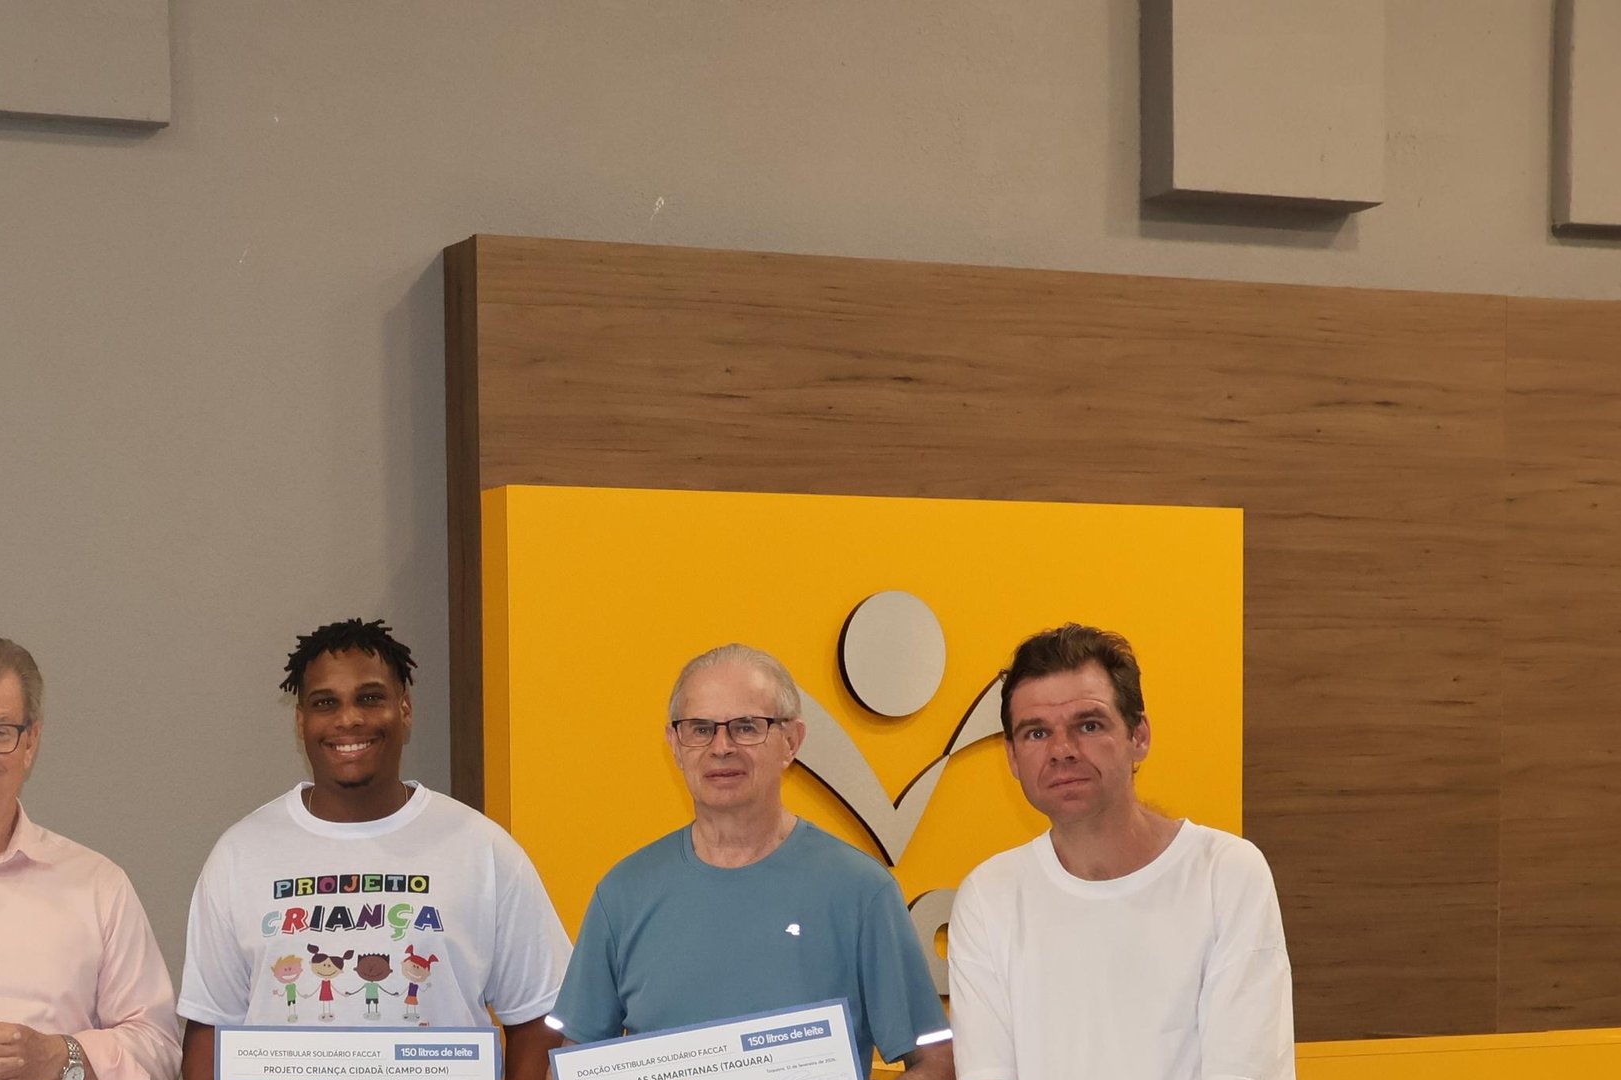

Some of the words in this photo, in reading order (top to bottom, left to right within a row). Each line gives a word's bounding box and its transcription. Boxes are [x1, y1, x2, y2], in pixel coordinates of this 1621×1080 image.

[274, 874, 429, 899] PROJETO
[261, 903, 444, 941] CRIANÇA
[748, 1037, 765, 1047] 150
[766, 1033, 788, 1043] litros
[790, 1029, 803, 1039] de
[804, 1026, 824, 1037] leite
[237, 1048, 269, 1058] DOAÇÃO
[270, 1050, 311, 1058] VESTIBULAR
[312, 1048, 351, 1058] SOLIDÁRIO
[352, 1050, 381, 1058] FACCAT
[401, 1048, 416, 1057] 150
[418, 1047, 439, 1057] litros
[440, 1048, 453, 1057] de
[454, 1047, 473, 1057] leite
[577, 1064, 610, 1078] DOAÇÃO
[611, 1058, 656, 1072] VESTIBULAR
[657, 1050, 697, 1064] SOLIDÁRIO
[698, 1045, 727, 1056] FACCAT
[263, 1066, 304, 1074] PROJETO
[306, 1066, 347, 1075] CRIANÇA
[349, 1064, 384, 1075] CIDADÃ
[385, 1066, 423, 1075] (CAMPO
[425, 1066, 450, 1075] BOM)
[720, 1053, 774, 1072] (TAQUARA)
